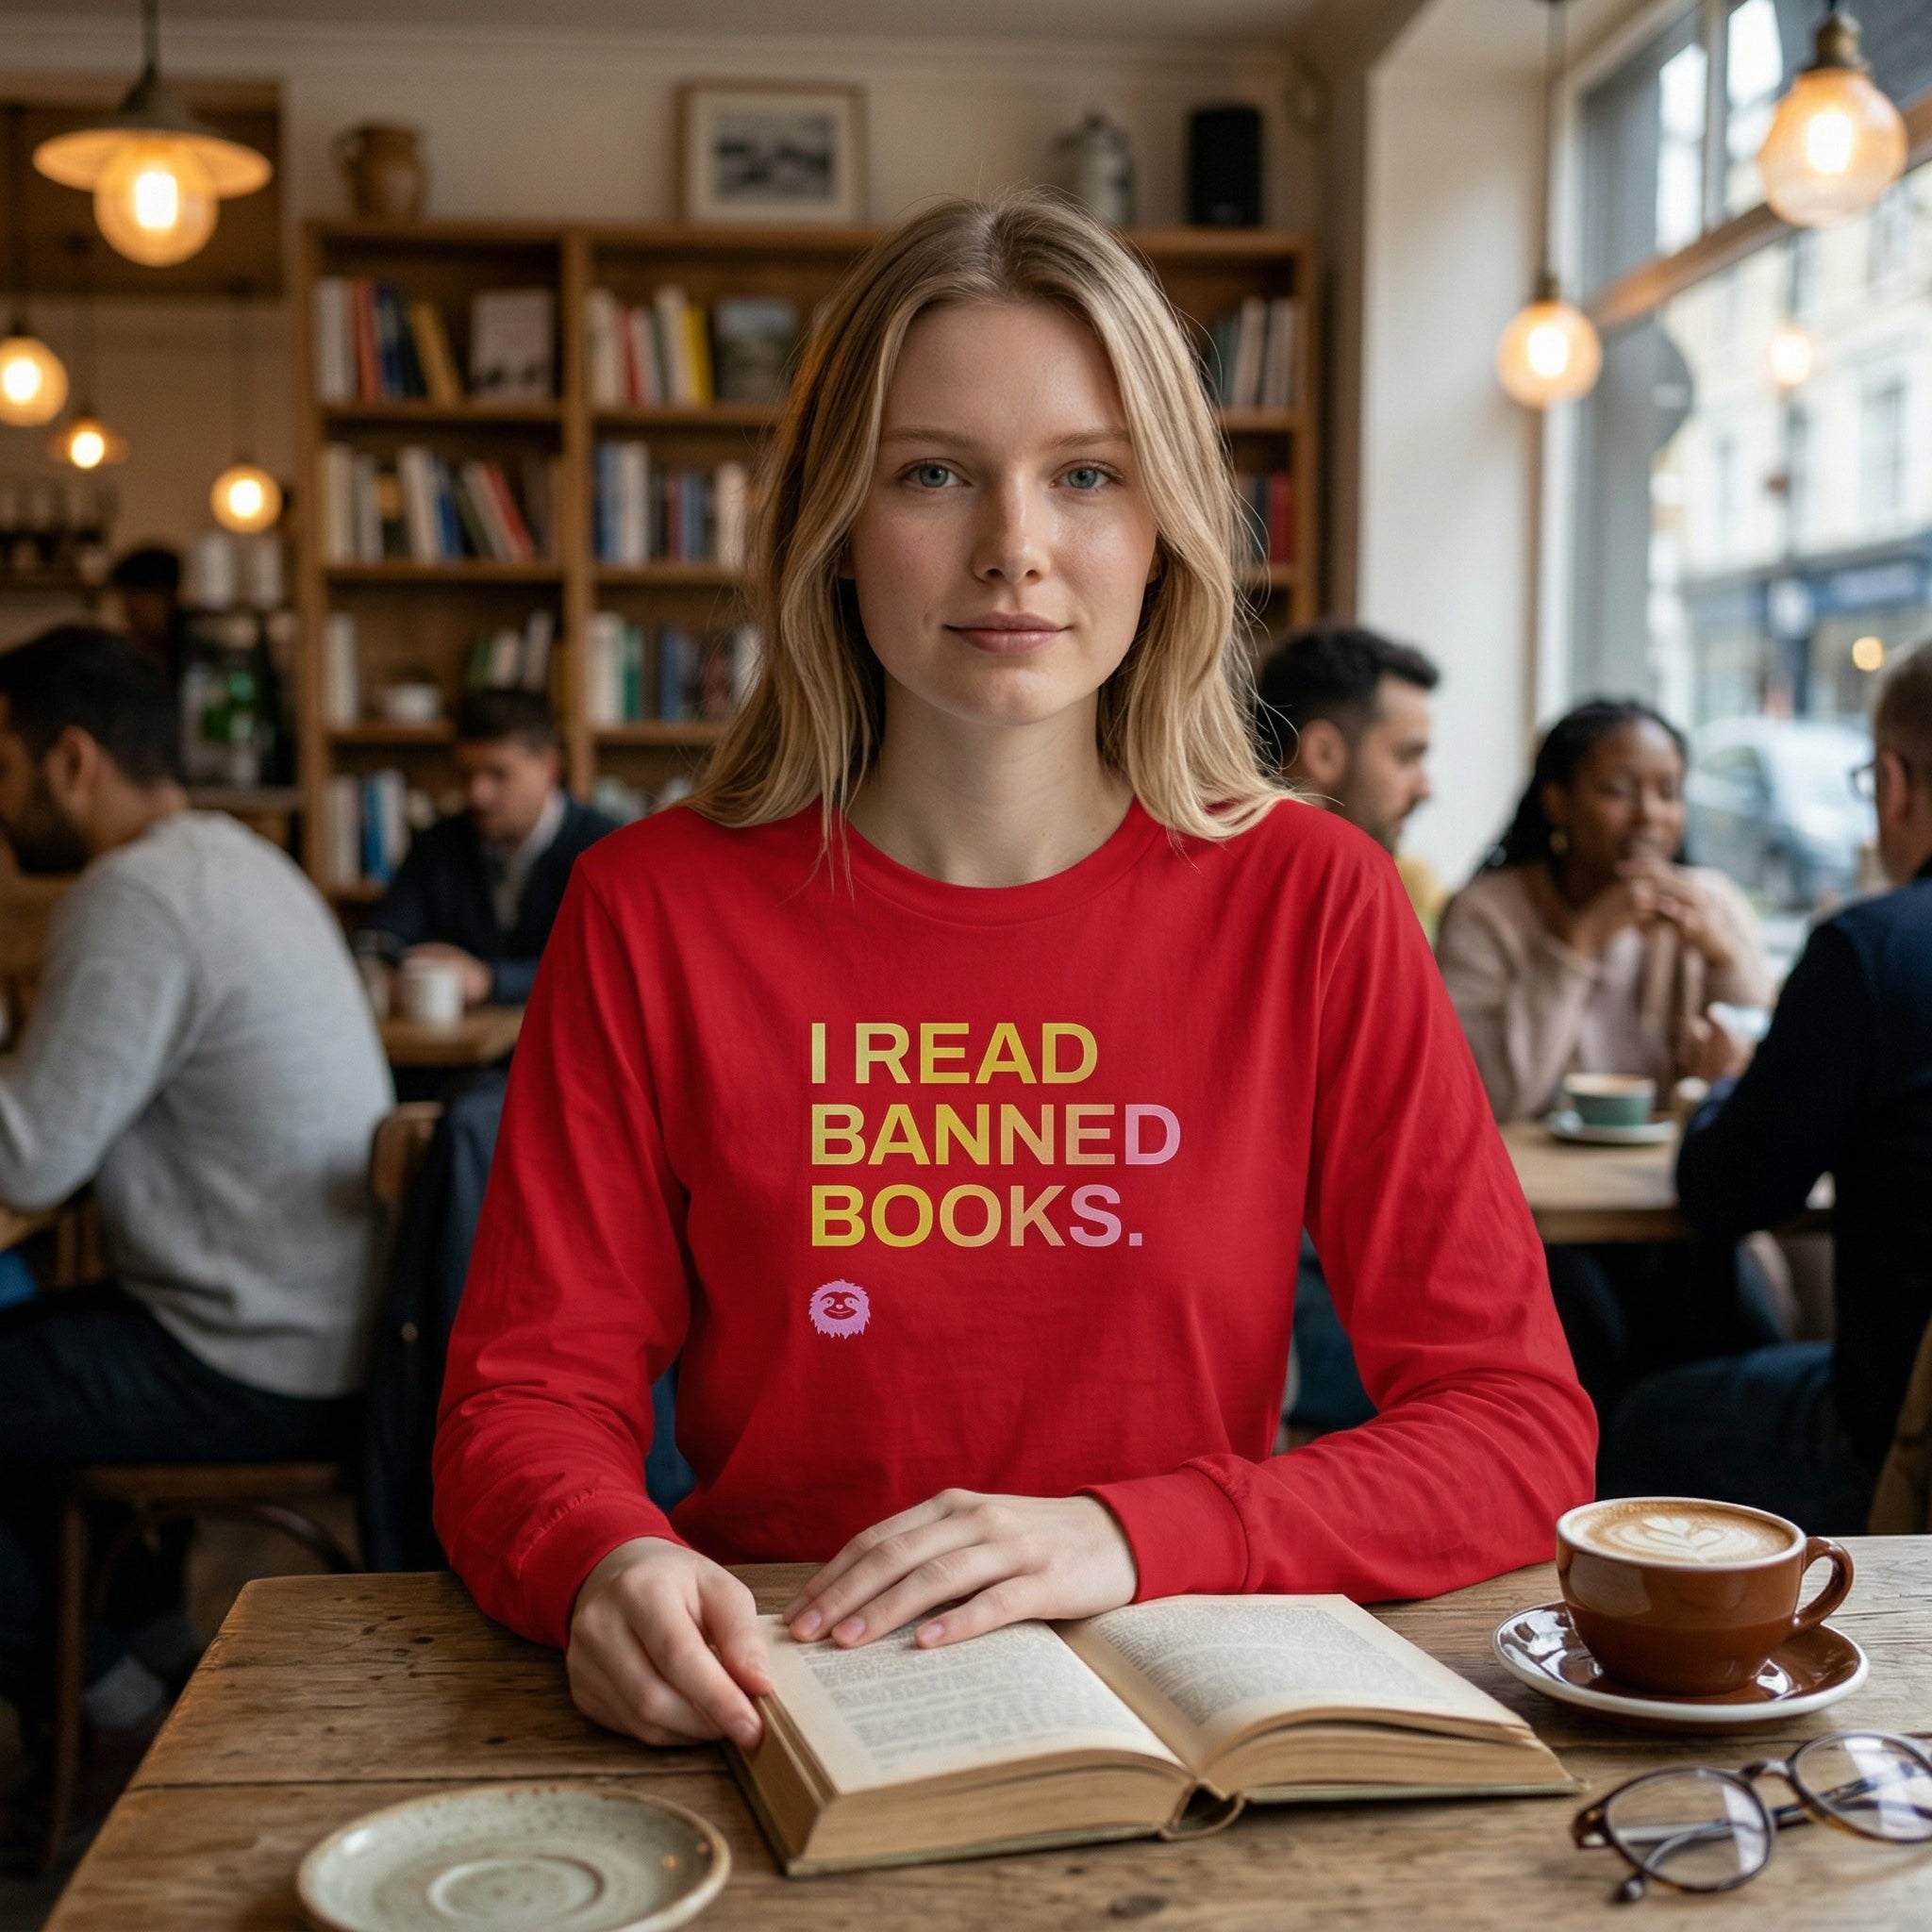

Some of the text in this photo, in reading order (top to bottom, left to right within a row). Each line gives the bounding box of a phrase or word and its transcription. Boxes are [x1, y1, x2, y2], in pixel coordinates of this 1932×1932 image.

[811, 1023, 1098, 1084] I READ
[811, 1104, 1181, 1165] BANNED
[811, 1184, 1143, 1247] BOOKS.
